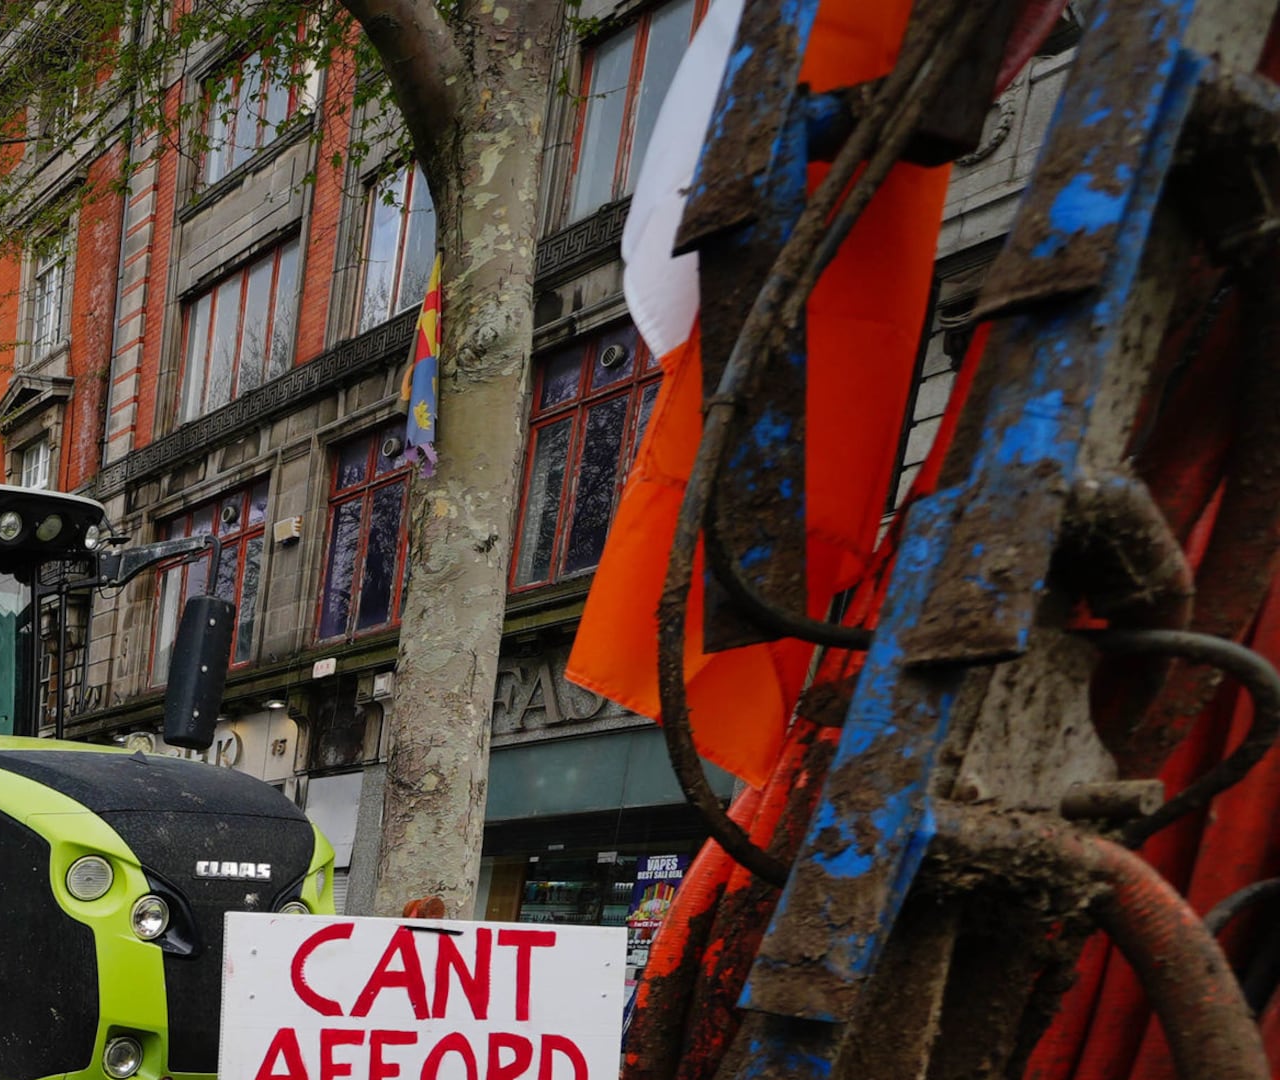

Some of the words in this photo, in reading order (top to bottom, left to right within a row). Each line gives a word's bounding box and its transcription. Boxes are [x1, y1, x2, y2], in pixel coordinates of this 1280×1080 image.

[196, 860, 271, 879] CLAAS
[648, 859, 678, 871] VAPES
[290, 923, 555, 1020] CANT
